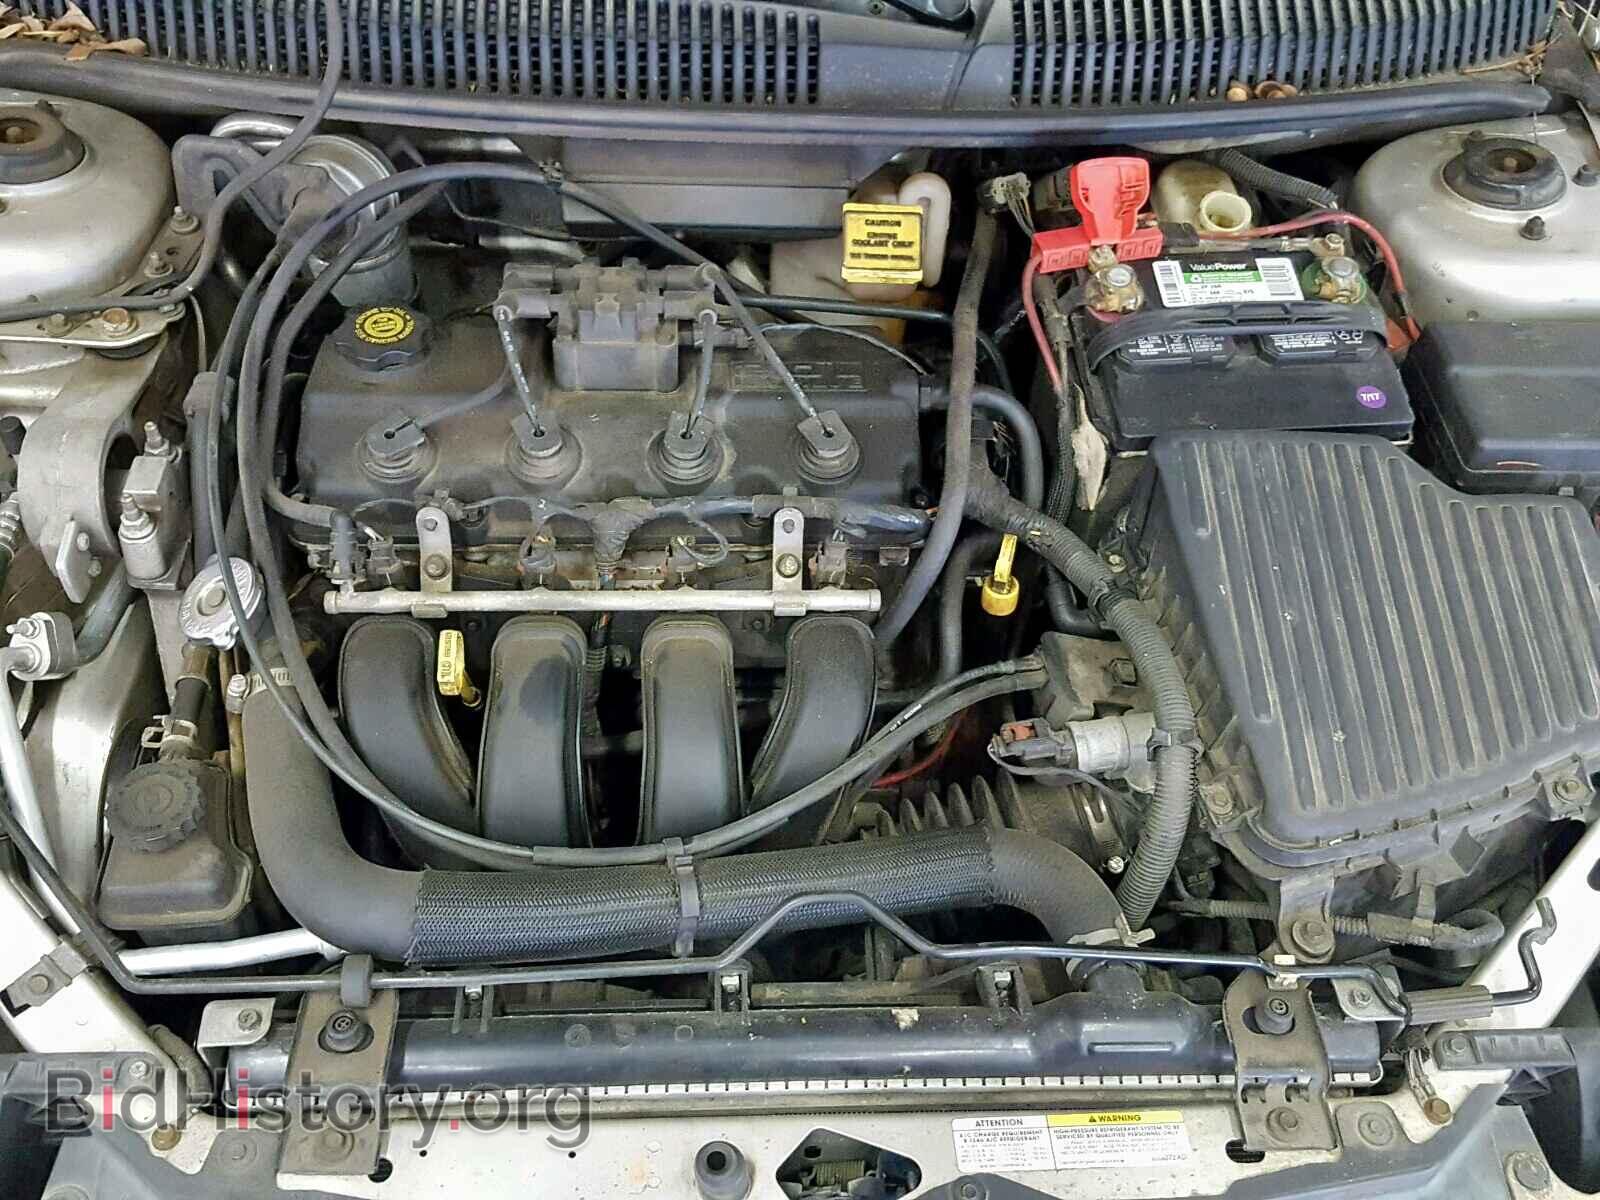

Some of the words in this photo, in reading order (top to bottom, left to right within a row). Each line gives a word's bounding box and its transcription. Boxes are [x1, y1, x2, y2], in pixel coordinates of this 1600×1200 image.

[865, 219, 901, 228] CAUTION
[852, 239, 889, 248] COOLANT
[892, 241, 914, 249] ONLY
[1190, 263, 1247, 272] ValuePower
[1098, 1114, 1141, 1122] WARNING
[975, 1119, 1023, 1127] ATTENTION
